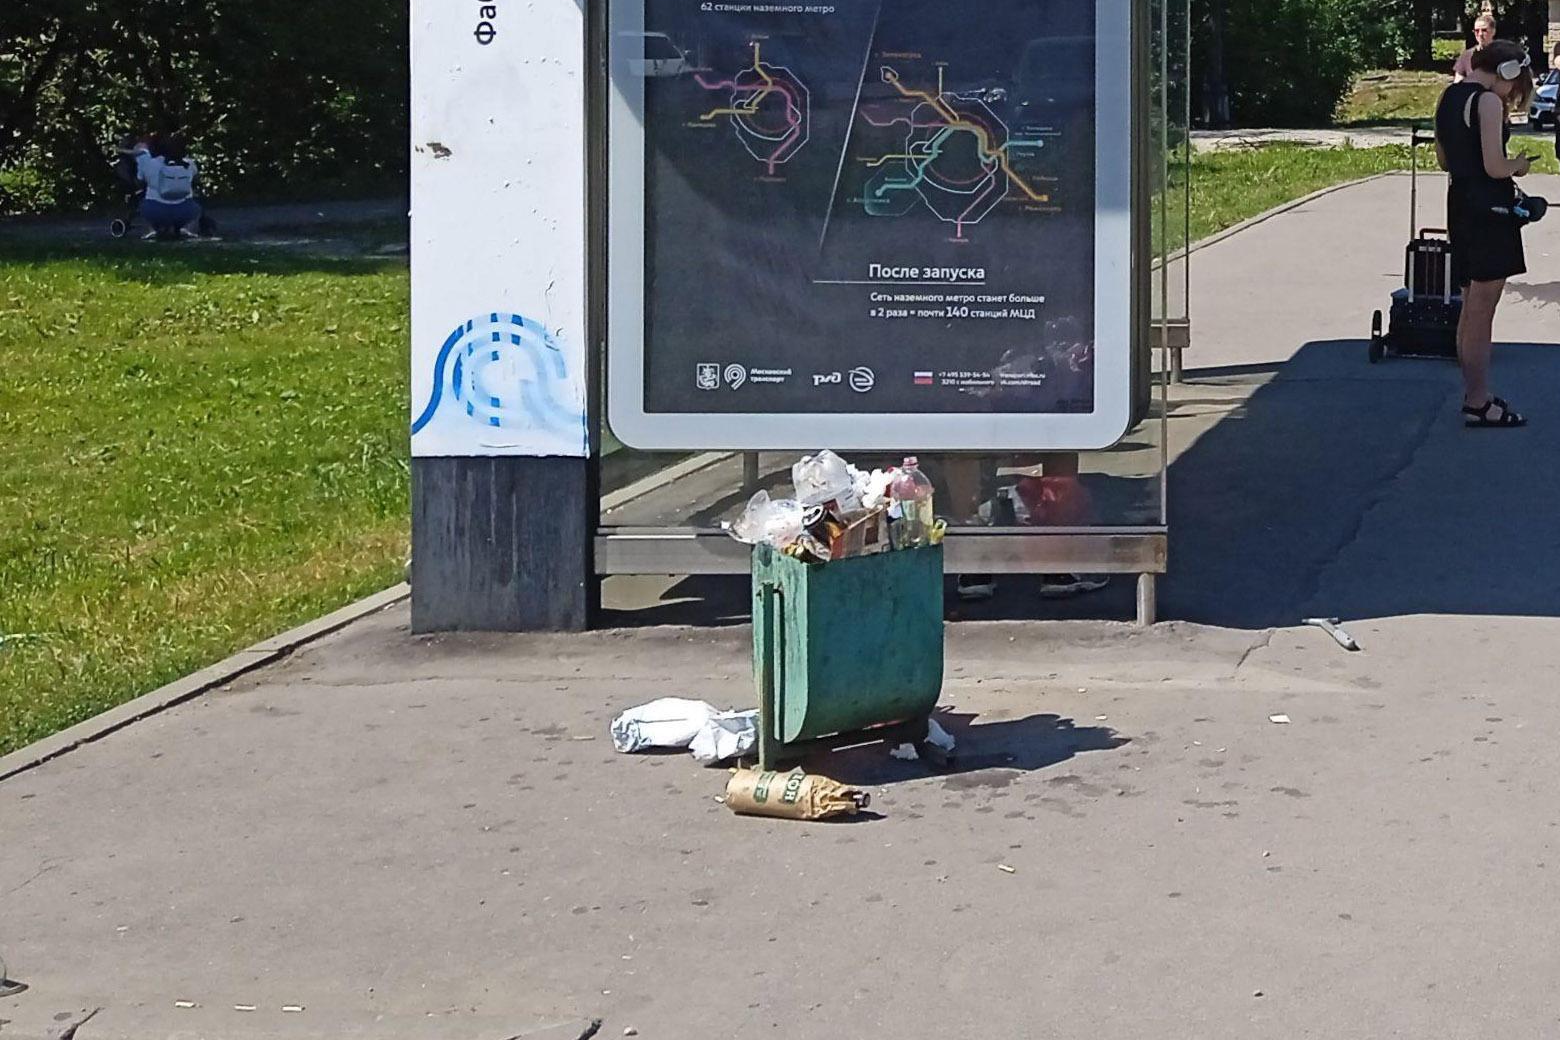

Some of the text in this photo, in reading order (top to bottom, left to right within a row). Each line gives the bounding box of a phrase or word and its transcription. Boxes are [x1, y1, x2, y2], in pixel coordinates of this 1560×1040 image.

[700, 2, 712, 11] 62
[753, 5, 803, 13] наземного
[869, 264, 985, 281] После запуска
[870, 292, 1045, 304] Сеть наземного метро станет больше
[878, 308, 884, 317] 2
[886, 310, 908, 318] раза
[917, 310, 945, 318] почти
[946, 307, 969, 318] 140
[1009, 309, 1036, 319] МЦД
